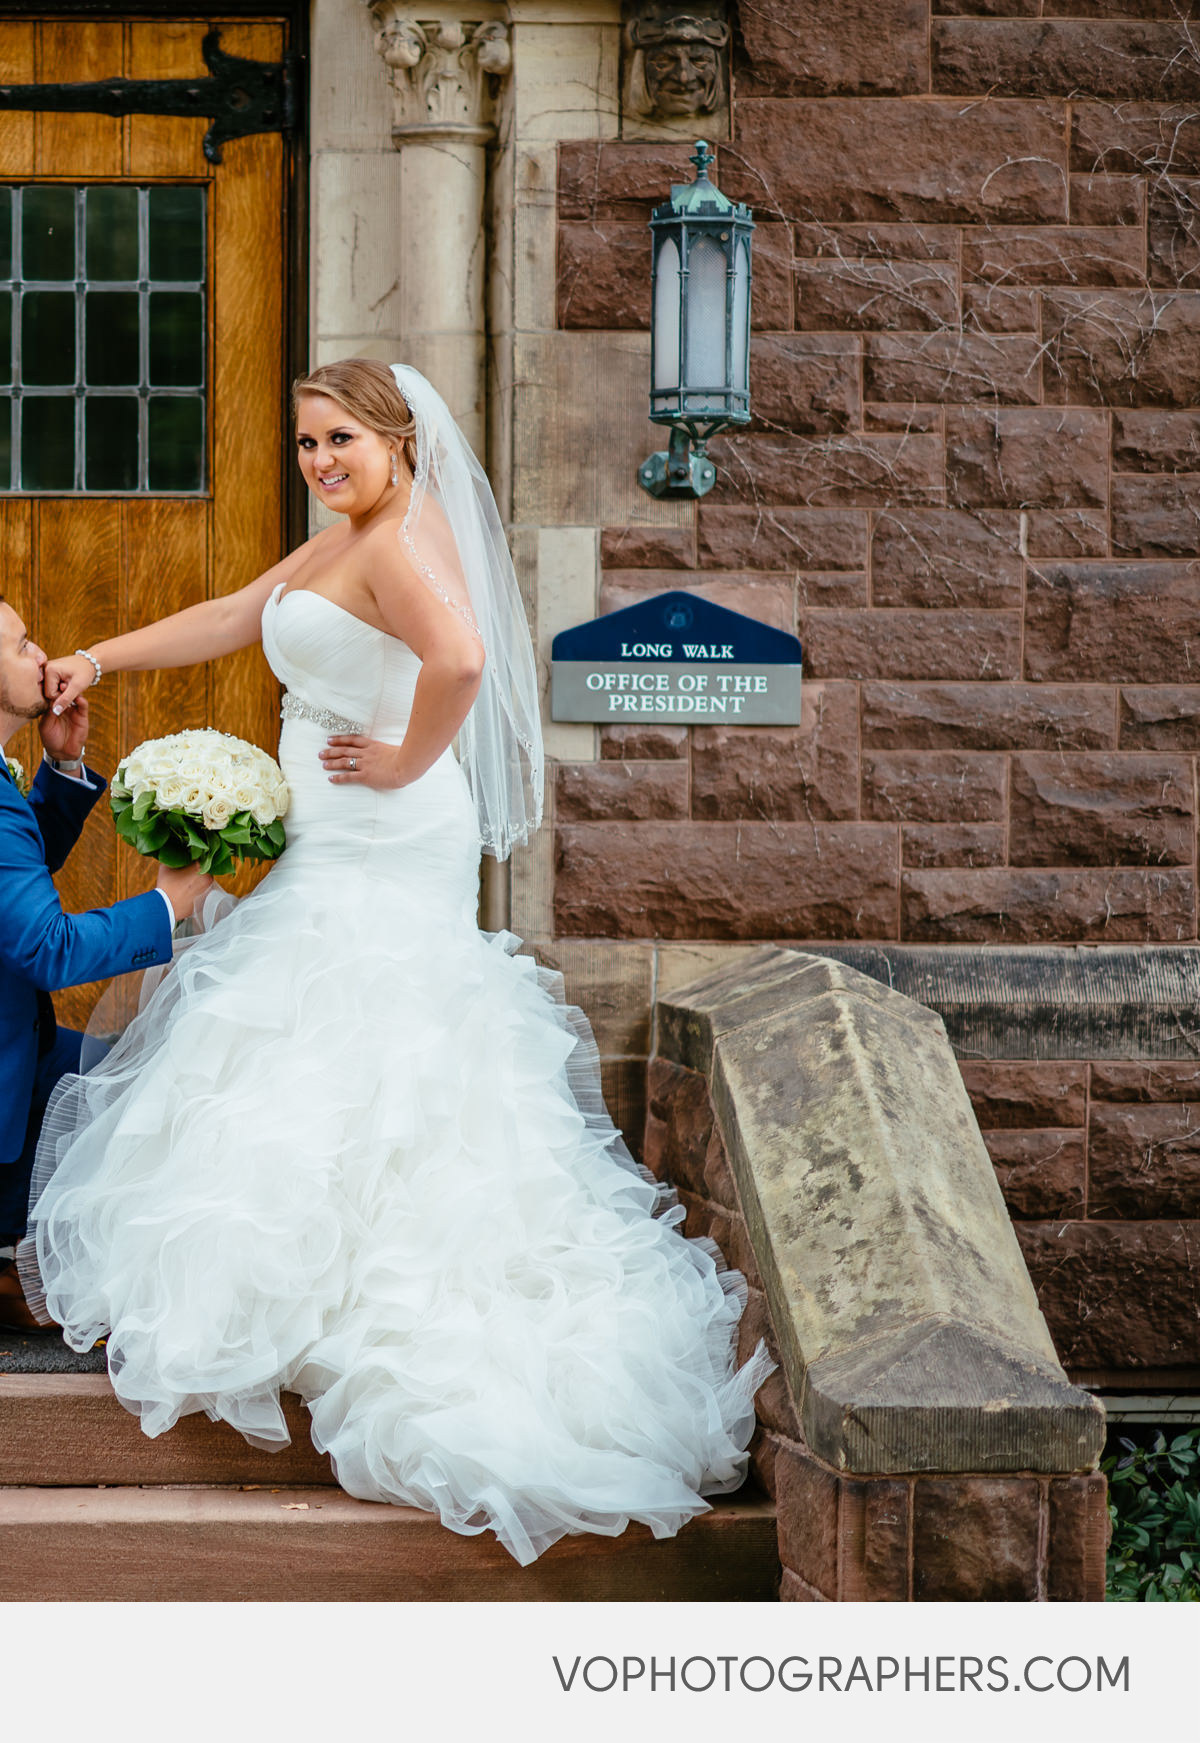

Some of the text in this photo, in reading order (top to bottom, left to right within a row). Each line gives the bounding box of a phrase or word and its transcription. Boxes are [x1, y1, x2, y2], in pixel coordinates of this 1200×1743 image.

[621, 643, 734, 659] LONG WALK
[586, 673, 768, 693] OFFICE OF THE
[608, 694, 746, 713] PRESIDENT
